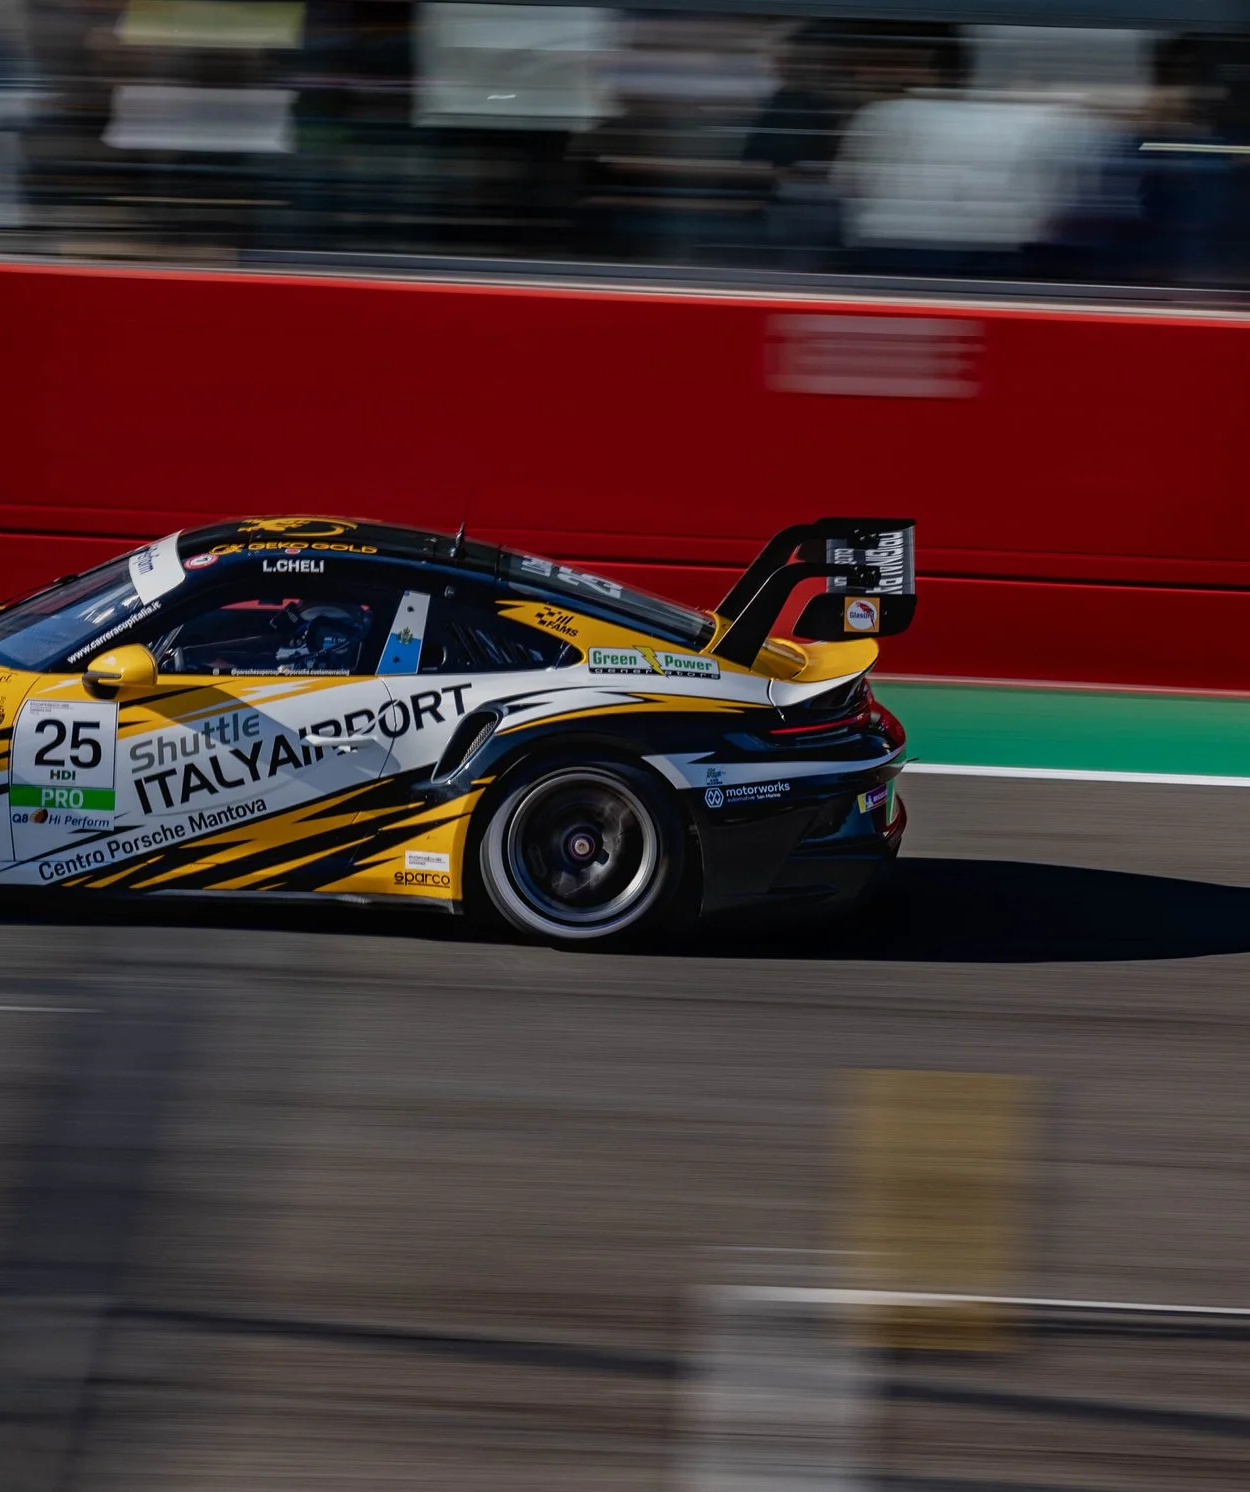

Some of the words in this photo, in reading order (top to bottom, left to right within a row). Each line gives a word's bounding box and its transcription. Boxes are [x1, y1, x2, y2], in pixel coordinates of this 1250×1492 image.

[248, 541, 309, 550] GEKO
[311, 542, 378, 554] GOLD
[262, 559, 325, 574] L.CHELI
[67, 600, 162, 665] www.carreracupitalia.it
[545, 620, 579, 637] FAMS
[592, 650, 638, 666] Green
[663, 654, 713, 671] Power
[34, 718, 102, 769] 25
[129, 713, 261, 775] Shuttle
[134, 683, 473, 816] ITALYAIRPORT
[49, 769, 76, 781] HDI
[41, 788, 85, 808] PRO
[726, 781, 790, 798] motorworks
[12, 813, 29, 824] Q8
[49, 814, 62, 824] Hi
[64, 815, 110, 828] Perform
[38, 849, 105, 881] Centro
[106, 823, 186, 859] Porsche
[187, 798, 268, 833] Mantova
[394, 871, 451, 888] sparco
